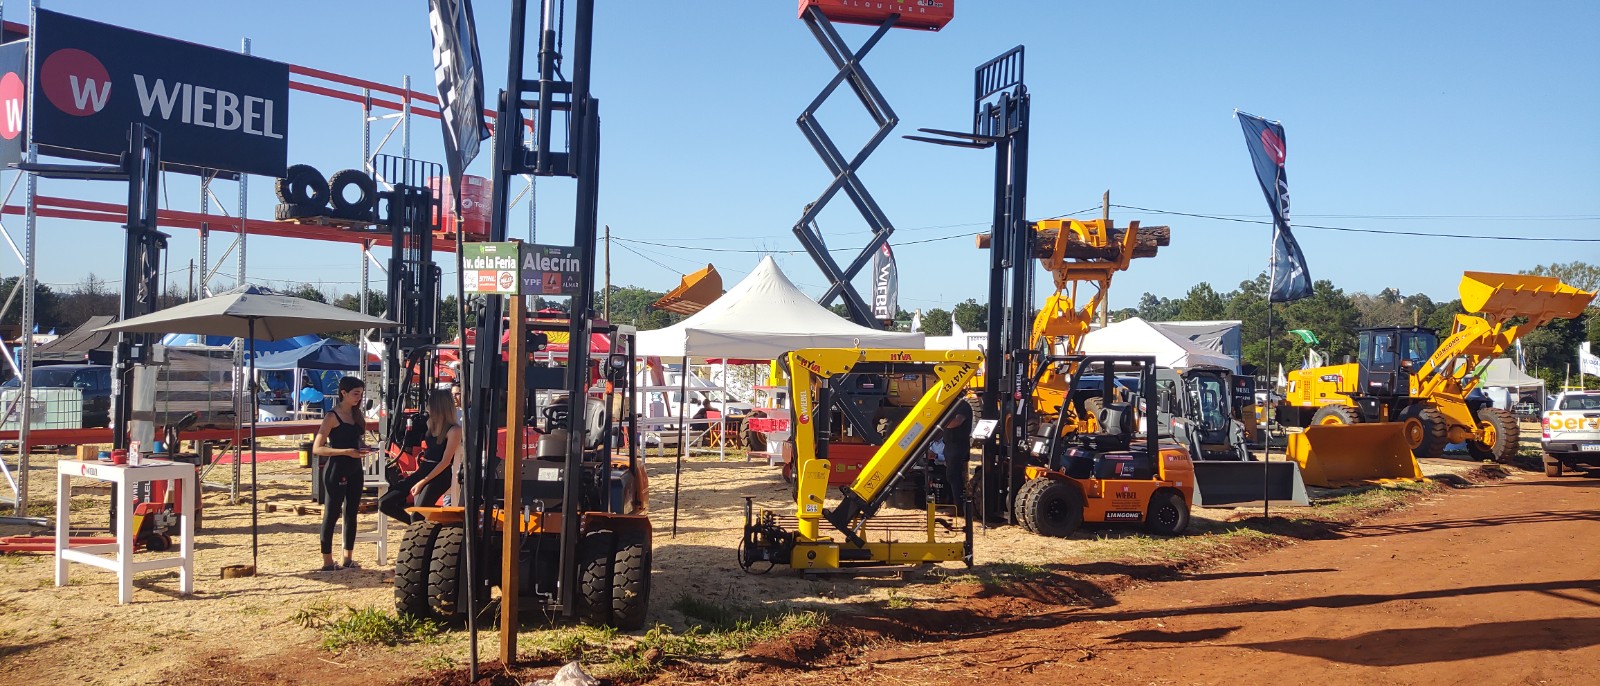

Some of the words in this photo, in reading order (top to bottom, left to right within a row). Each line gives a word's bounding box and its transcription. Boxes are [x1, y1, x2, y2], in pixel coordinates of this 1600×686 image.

[843, 1, 925, 13] ALQUILER
[70, 75, 112, 113] W
[133, 73, 283, 139] WIEBEL
[474, 256, 486, 269] de
[486, 256, 494, 269] la
[495, 255, 516, 269] Feria
[522, 252, 580, 272] Alecrín
[479, 275, 496, 283] STIHL
[524, 278, 542, 286] YPF
[890, 351, 912, 361] HYVA
[800, 357, 822, 374] HYVA
